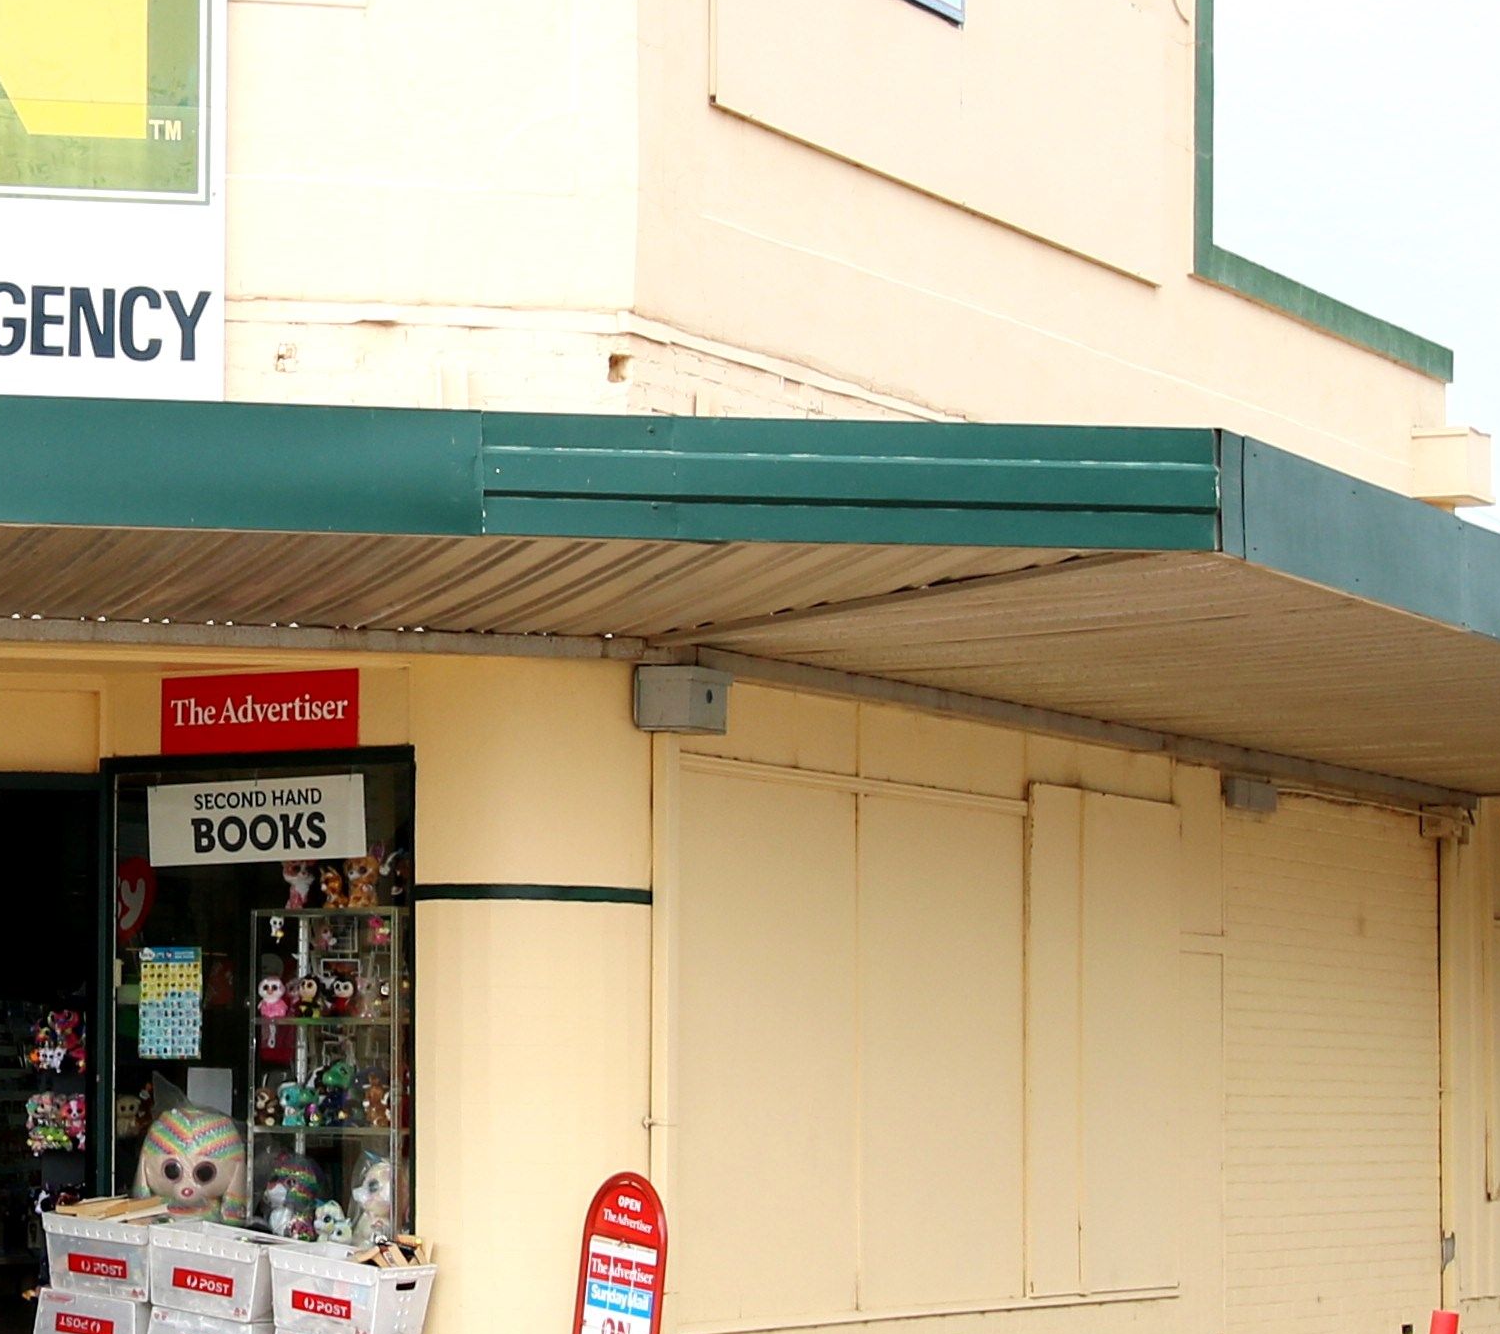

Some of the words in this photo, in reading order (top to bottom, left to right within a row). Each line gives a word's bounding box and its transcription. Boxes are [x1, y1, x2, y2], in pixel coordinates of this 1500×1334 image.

[150, 119, 183, 142] TM
[170, 698, 216, 727] The
[217, 693, 349, 725] Advertiser
[193, 789, 267, 811] SECOND
[271, 787, 322, 807] HAND
[190, 811, 328, 854] BOOKS
[117, 876, 146, 931] y
[617, 1195, 642, 1213] OPEN
[603, 1208, 618, 1221] The
[616, 1213, 653, 1234] Advertiser
[92, 1261, 124, 1276] POST
[591, 1257, 609, 1276] The
[608, 1262, 654, 1285] Advertiser
[199, 1278, 231, 1295] POST
[590, 1283, 628, 1309] Sunday
[627, 1289, 650, 1312] Mail
[316, 1300, 348, 1317] POST
[59, 1314, 89, 1329] POST
